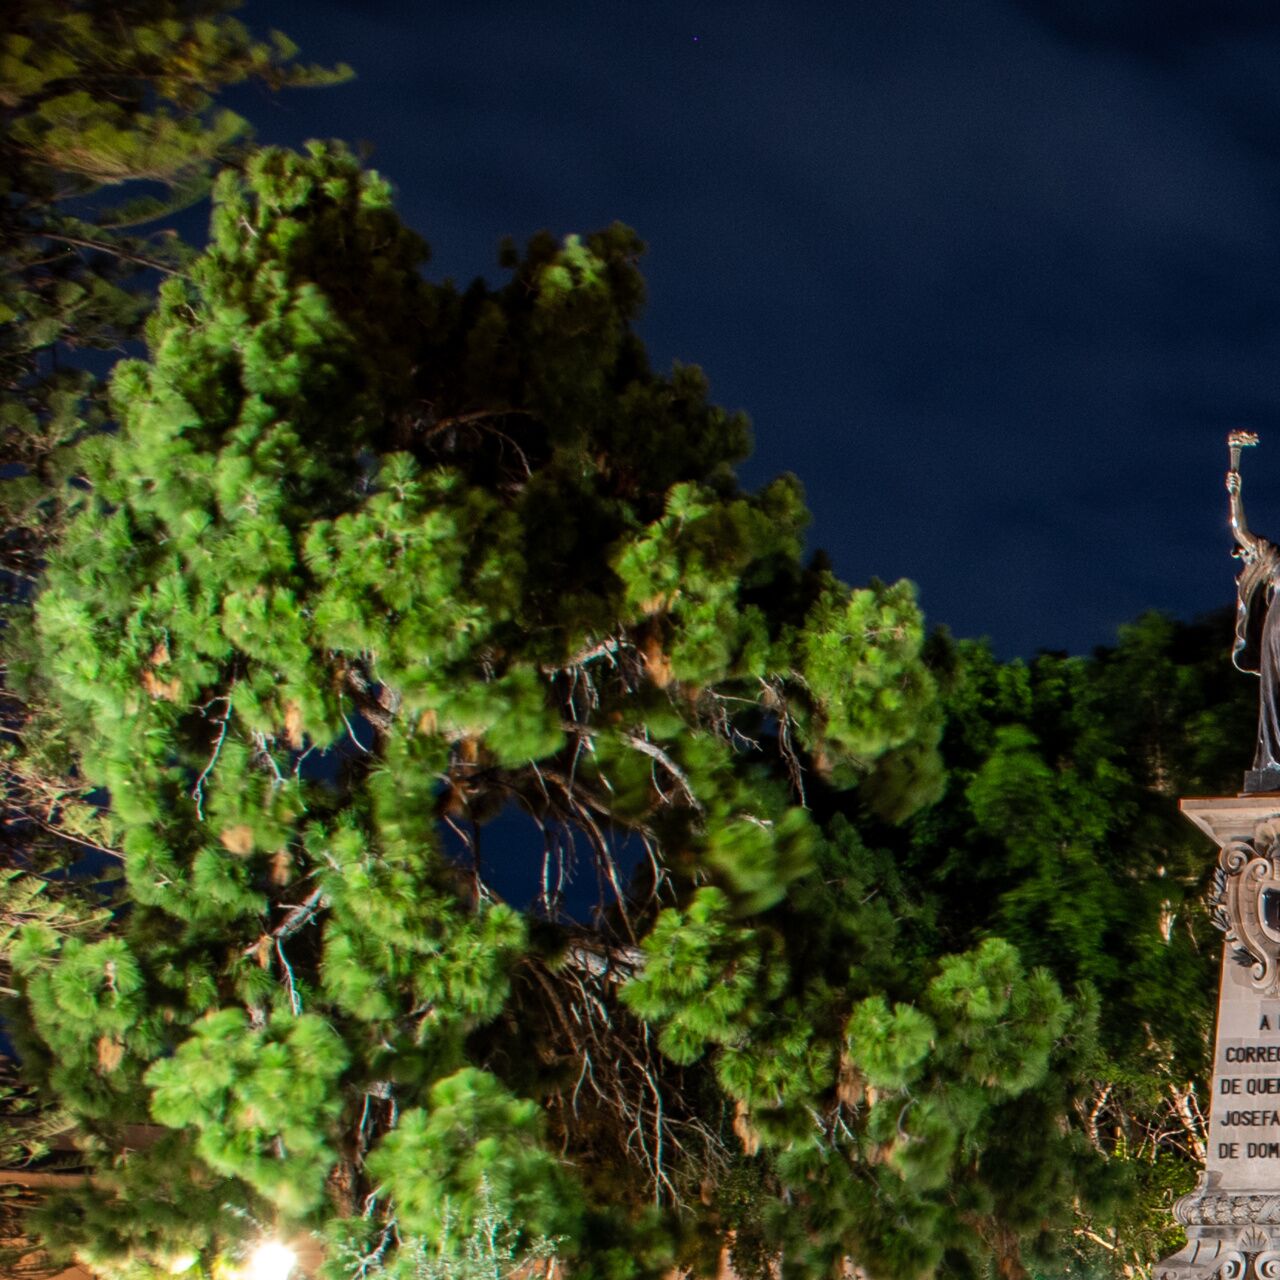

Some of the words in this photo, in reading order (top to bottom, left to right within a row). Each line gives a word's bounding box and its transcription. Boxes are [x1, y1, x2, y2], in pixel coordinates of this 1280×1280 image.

[1259, 1014, 1271, 1030] A
[1220, 1079, 1241, 1094] DE
[1220, 1110, 1280, 1126] JOSEFA
[1218, 1143, 1239, 1158] DE
